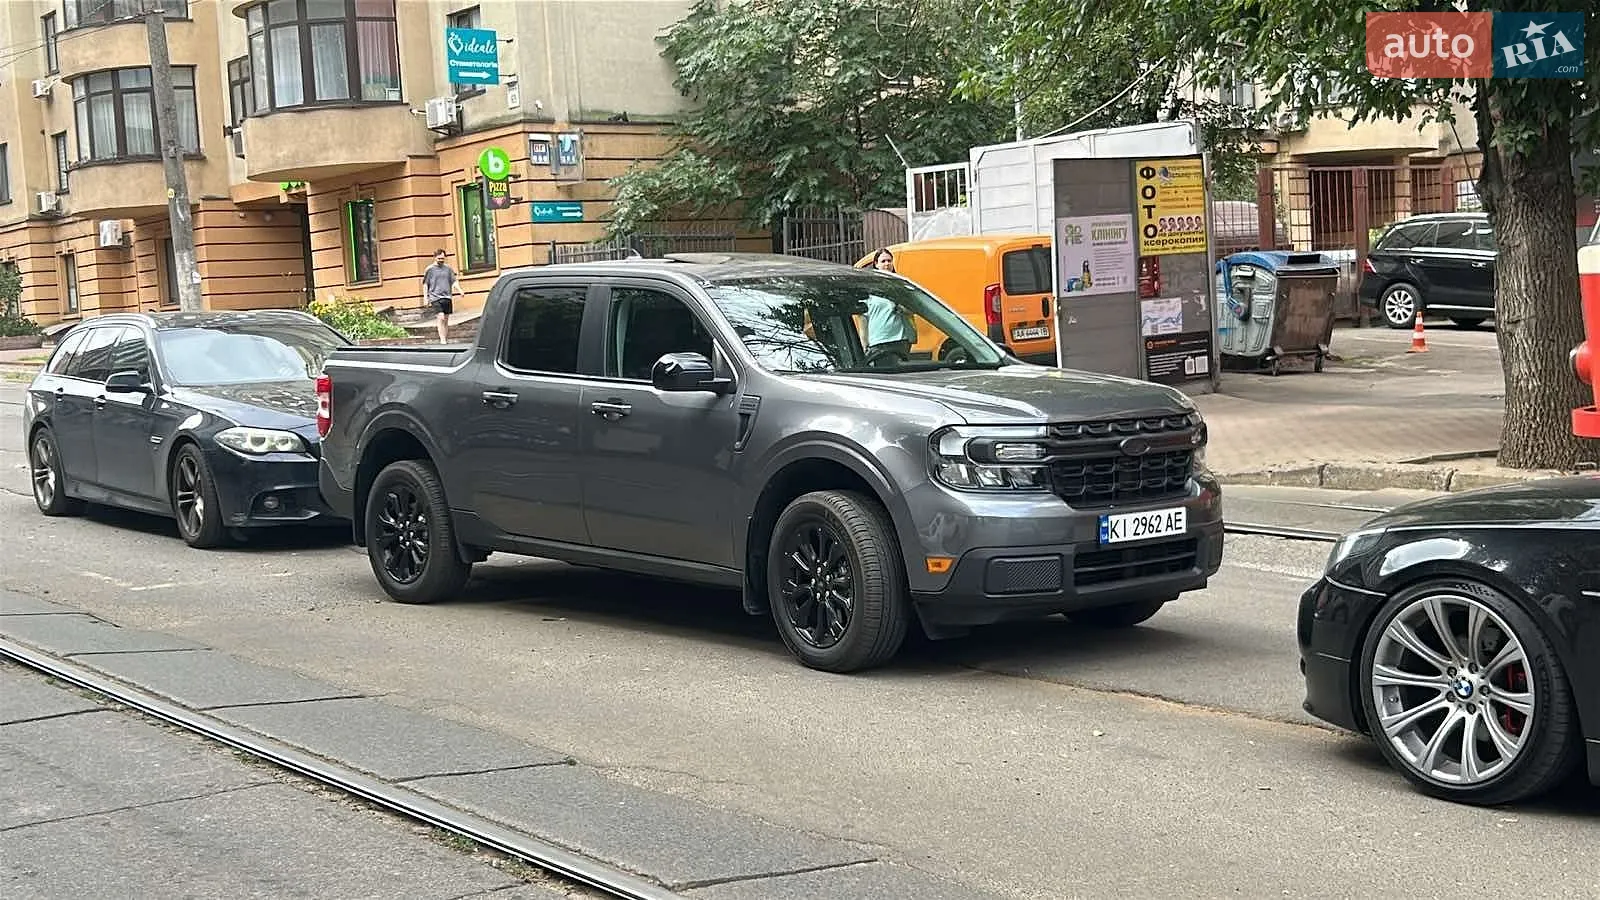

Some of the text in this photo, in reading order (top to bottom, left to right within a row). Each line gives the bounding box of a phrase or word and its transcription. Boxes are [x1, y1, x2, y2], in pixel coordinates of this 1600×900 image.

[464, 37, 496, 54] ideale
[1140, 166, 1158, 239] ФОТО
[1144, 237, 1205, 247] ксерокопия
[1110, 511, 1183, 540] KI 2962 AE
